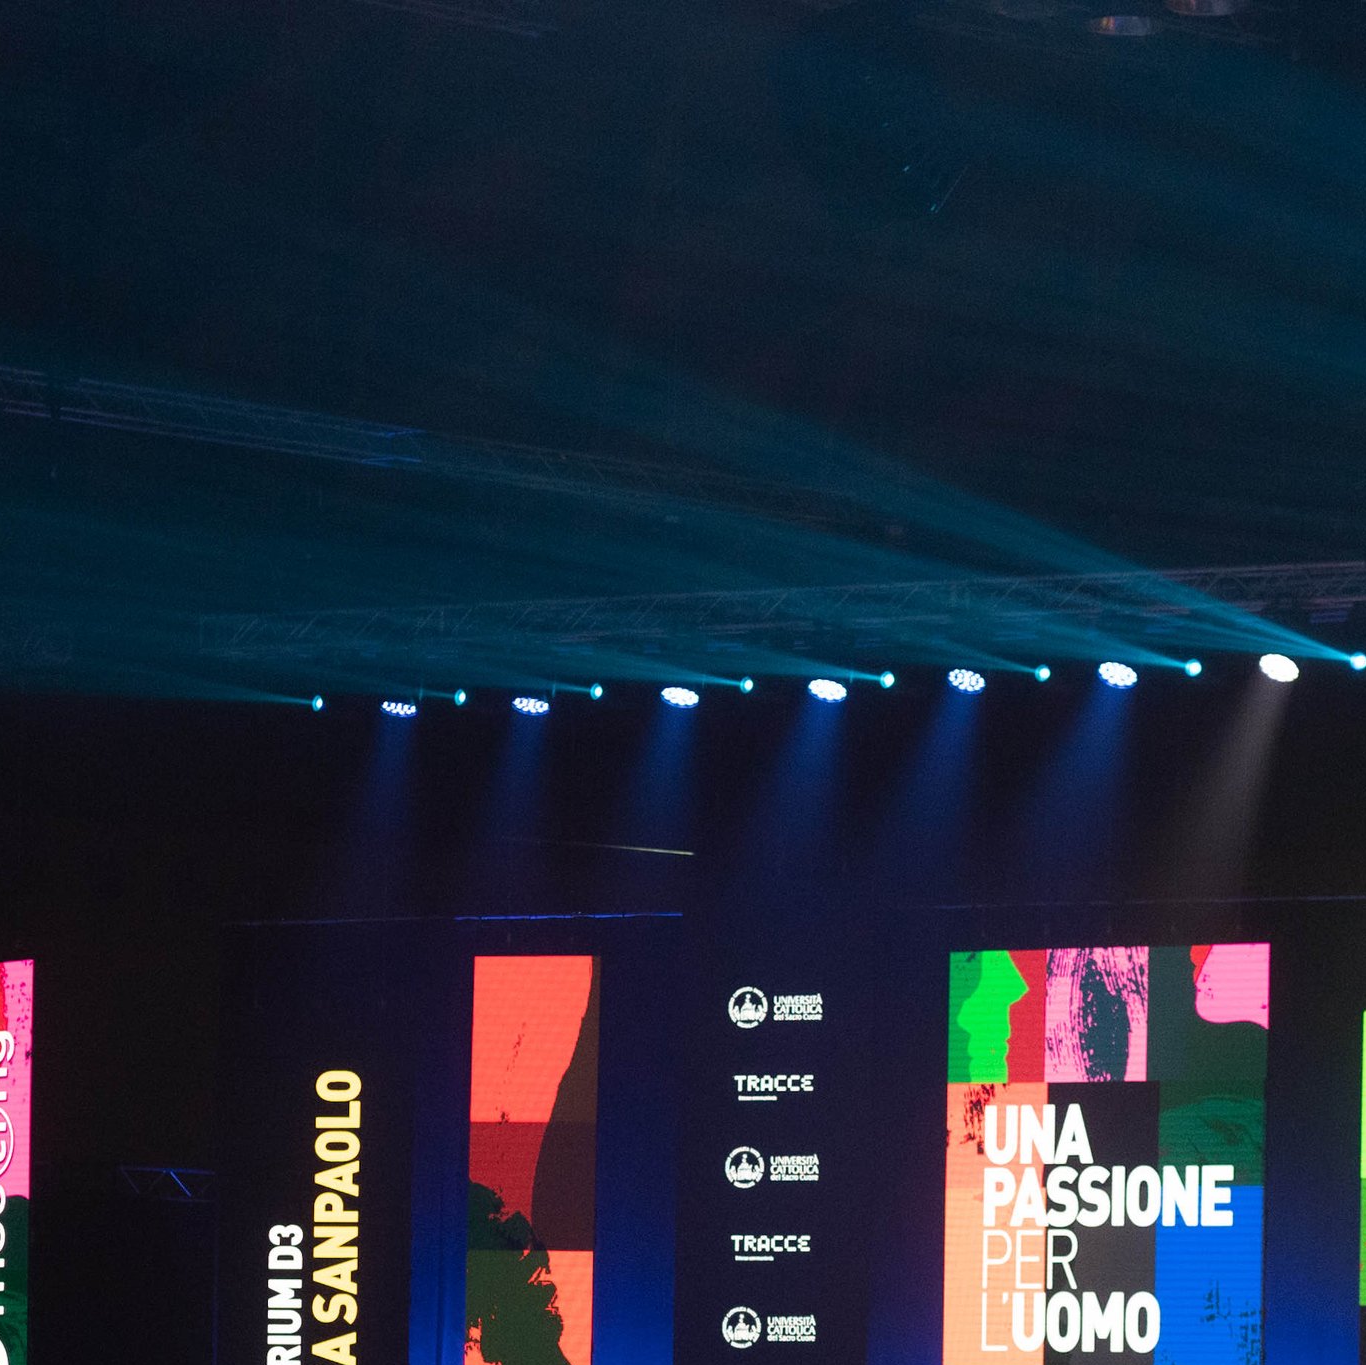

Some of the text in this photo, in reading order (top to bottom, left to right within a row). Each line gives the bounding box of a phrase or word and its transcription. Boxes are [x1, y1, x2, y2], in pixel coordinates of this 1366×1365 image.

[773, 993, 823, 1005] UNIVERSITÀ
[773, 1004, 823, 1014] CATTOLICA
[733, 1074, 814, 1092] TRACCE
[984, 1103, 1094, 1165] UNA
[770, 1153, 820, 1165] UNIVERSITÀ
[770, 1164, 819, 1174] CATTOLICA
[311, 1070, 362, 1325] SANPAOLO
[983, 1165, 1234, 1228] PASSIONE
[268, 1224, 304, 1271] D3
[730, 1235, 811, 1252] TRACCE
[982, 1228, 1079, 1290] PER
[767, 1314, 816, 1326] UNIVERSITÀ
[981, 1290, 1161, 1354] L'UOMO
[767, 1325, 816, 1335] CATTOLICA
